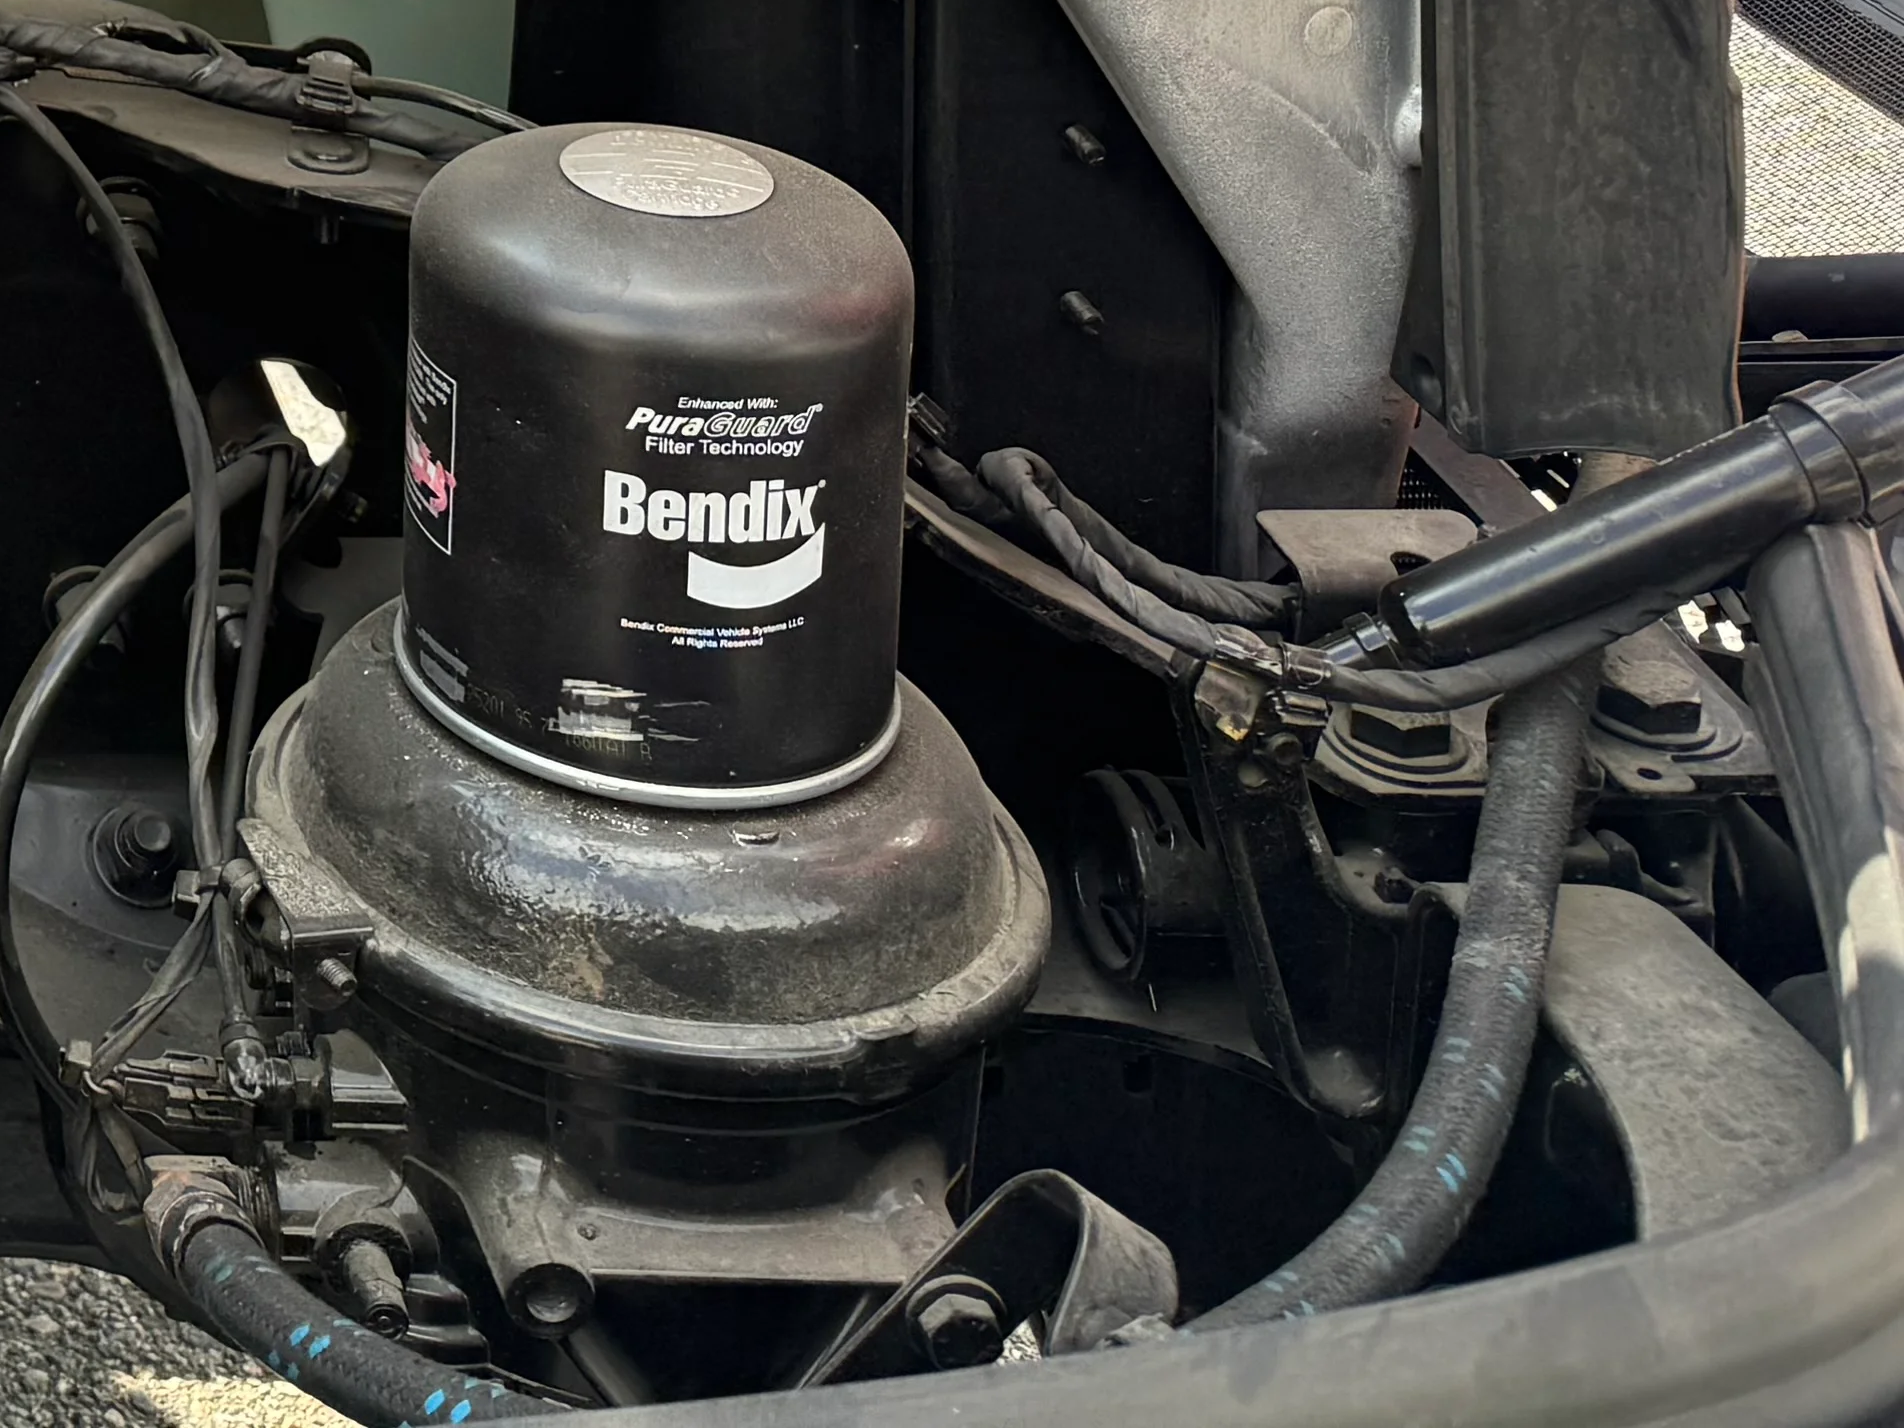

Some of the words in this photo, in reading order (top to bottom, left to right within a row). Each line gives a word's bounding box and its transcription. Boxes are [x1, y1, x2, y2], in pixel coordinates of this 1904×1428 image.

[678, 397, 744, 410] Enhanced
[747, 397, 779, 410] With:
[645, 436, 694, 455] Filter
[699, 439, 804, 458] Technology
[603, 469, 819, 544] Bendix
[620, 618, 655, 632] Bendix
[656, 623, 714, 637] Commercial
[716, 628, 750, 637] Vehicle
[752, 622, 787, 636] Systems
[788, 616, 805, 629] LLC
[671, 636, 685, 646] All
[686, 637, 718, 649] Rights
[720, 637, 763, 648] Reserved
